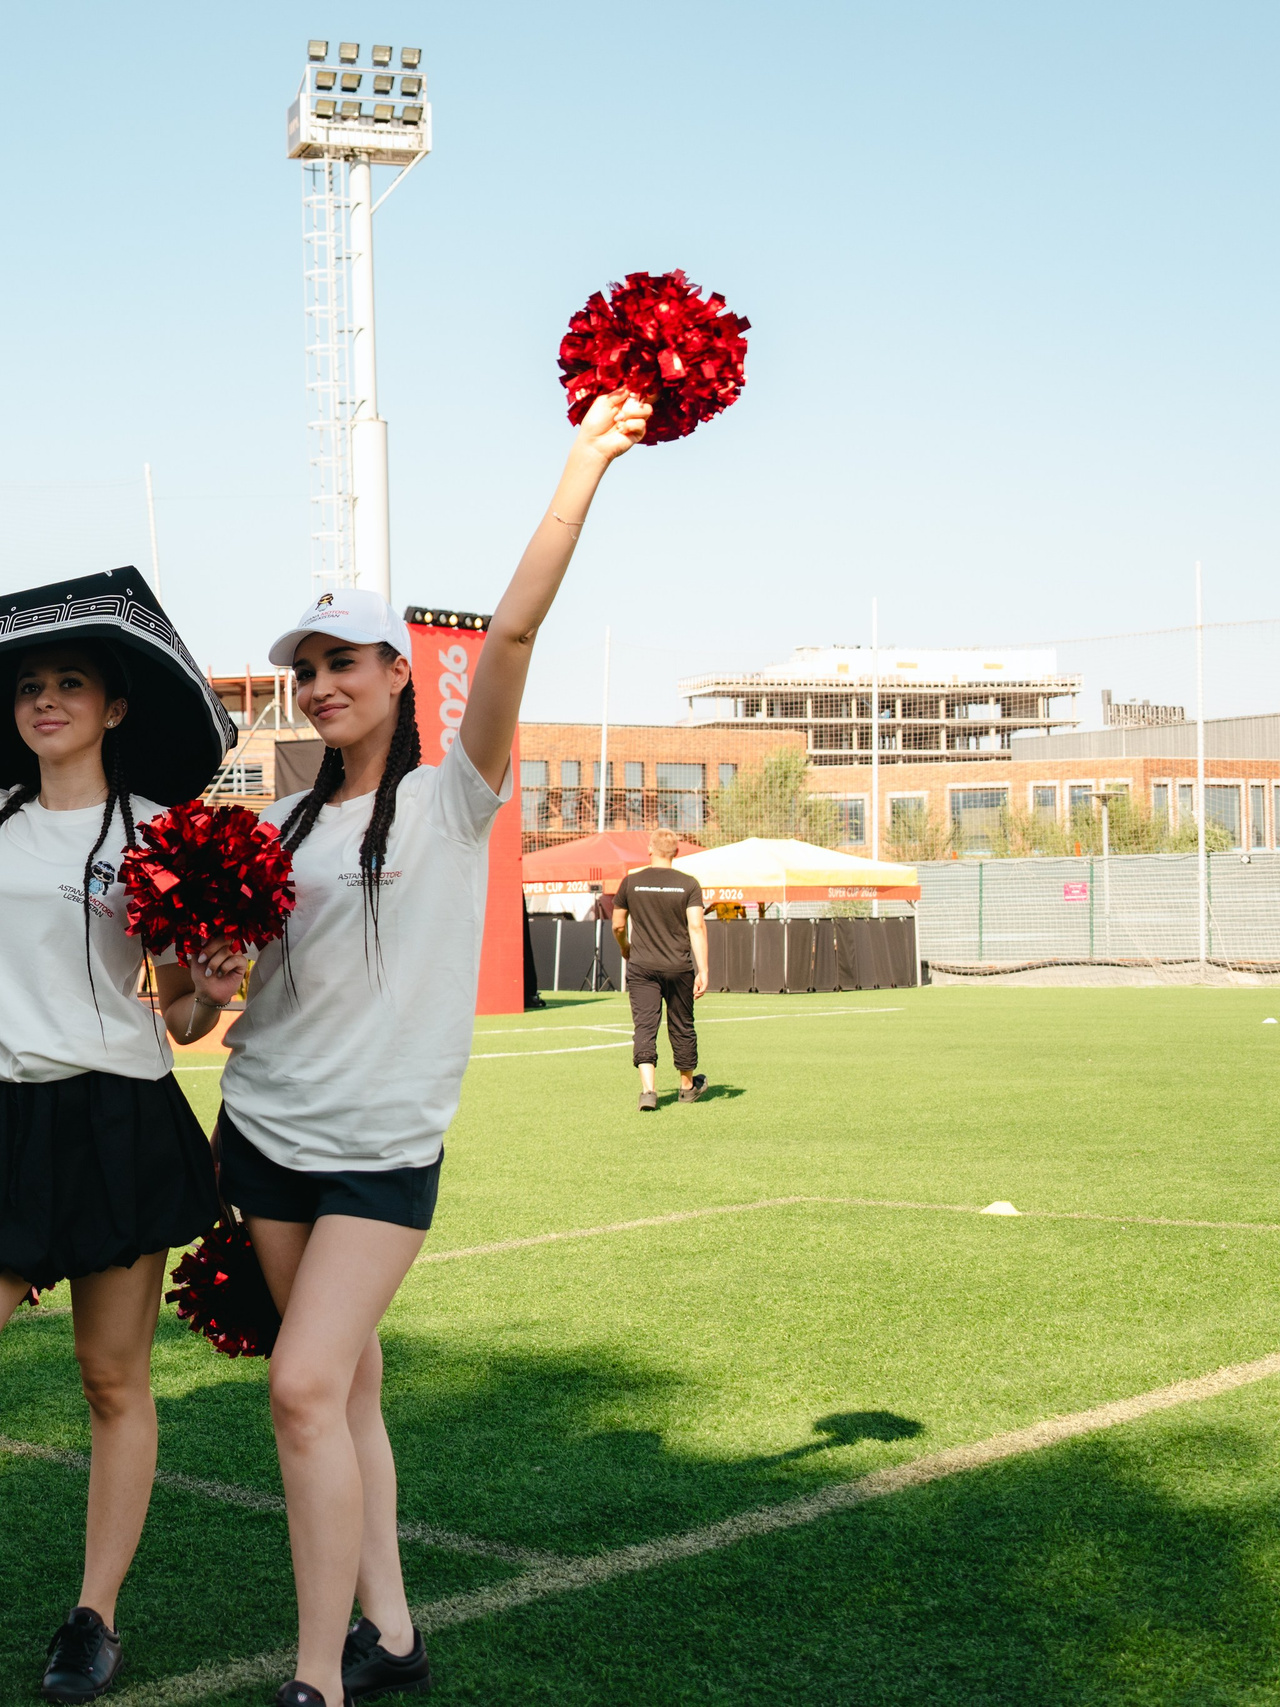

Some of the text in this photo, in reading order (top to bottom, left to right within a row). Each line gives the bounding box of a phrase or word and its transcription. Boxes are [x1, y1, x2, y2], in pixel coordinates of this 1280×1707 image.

[522, 881, 588, 894] UPER CUP 2026
[702, 888, 744, 900] UP 2026
[828, 887, 877, 898] SUPER CUP 2026
[63, 892, 104, 918] UZBESTAN
[88, 896, 114, 918] MOTORS
